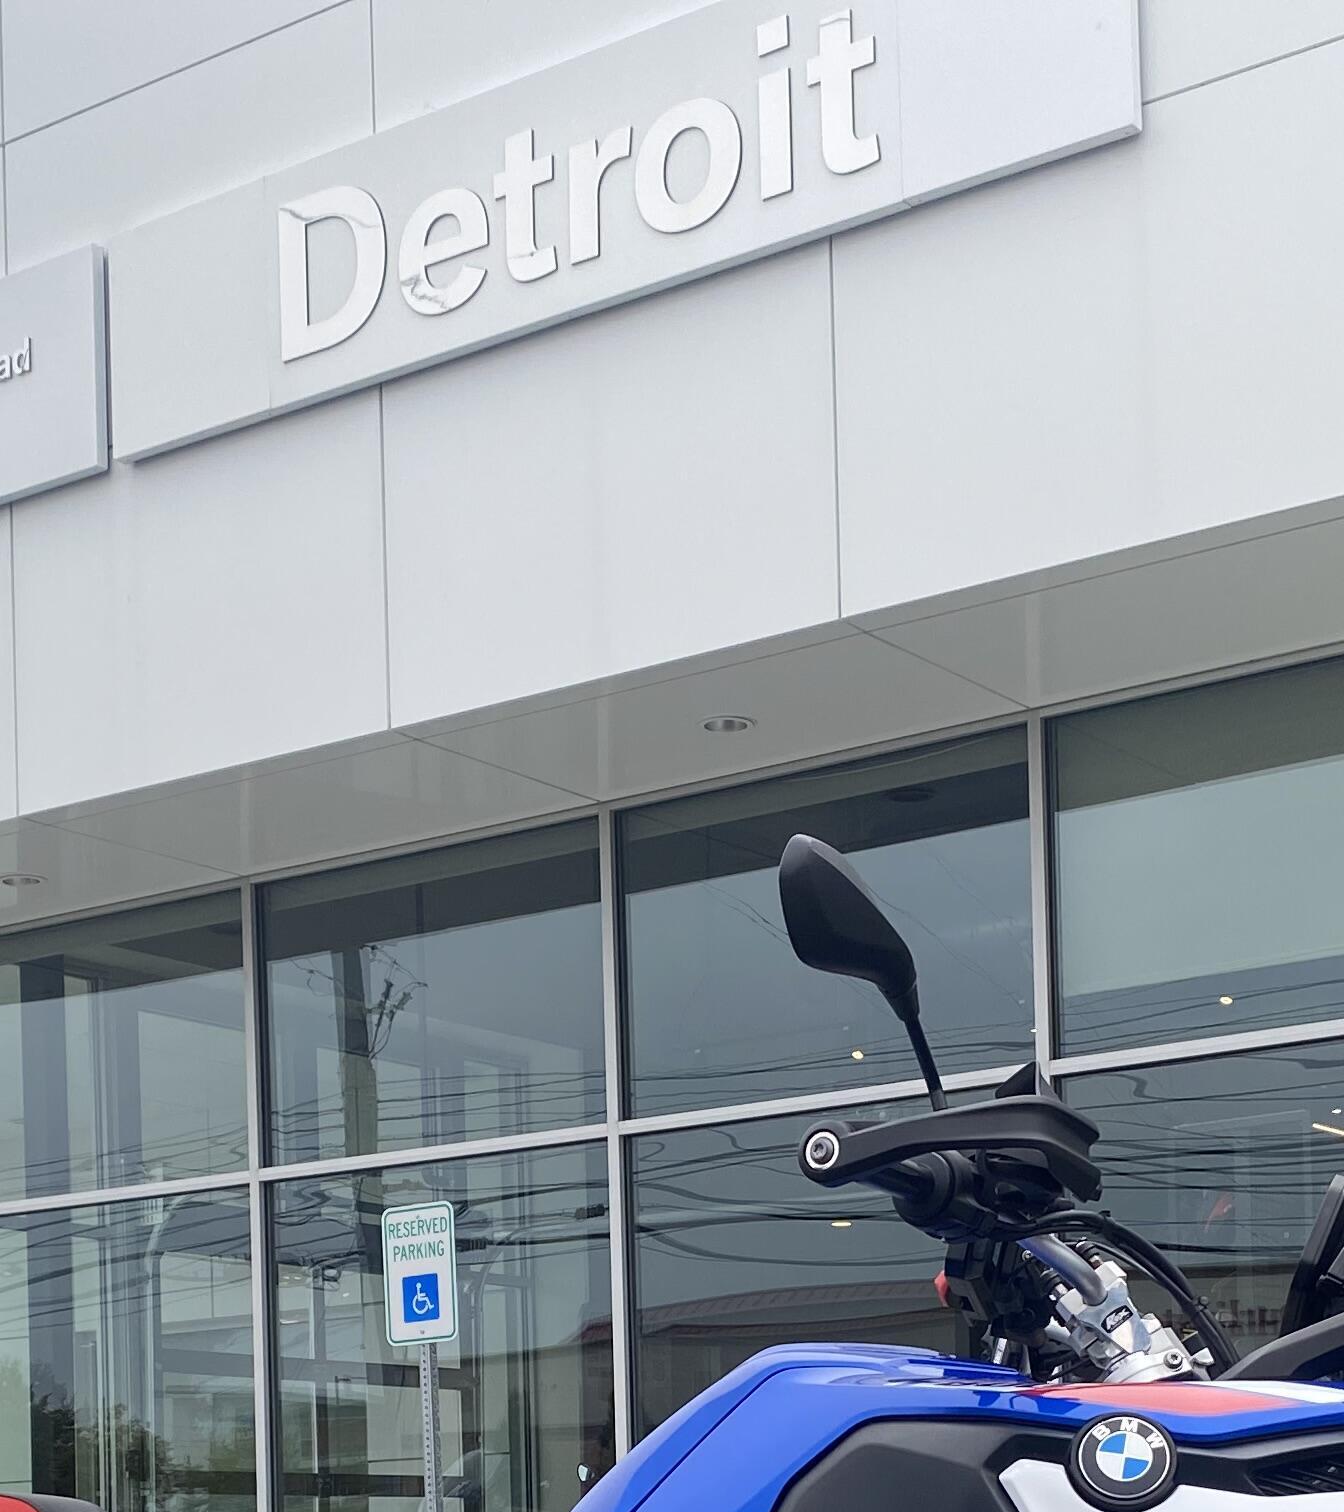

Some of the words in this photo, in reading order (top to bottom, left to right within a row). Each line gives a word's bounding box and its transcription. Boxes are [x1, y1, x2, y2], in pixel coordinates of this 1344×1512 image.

[277, 8, 882, 364] Detroit
[388, 1216, 448, 1241] RESERVED
[393, 1240, 445, 1262] PARKING
[1091, 1418, 1164, 1449] BMW
